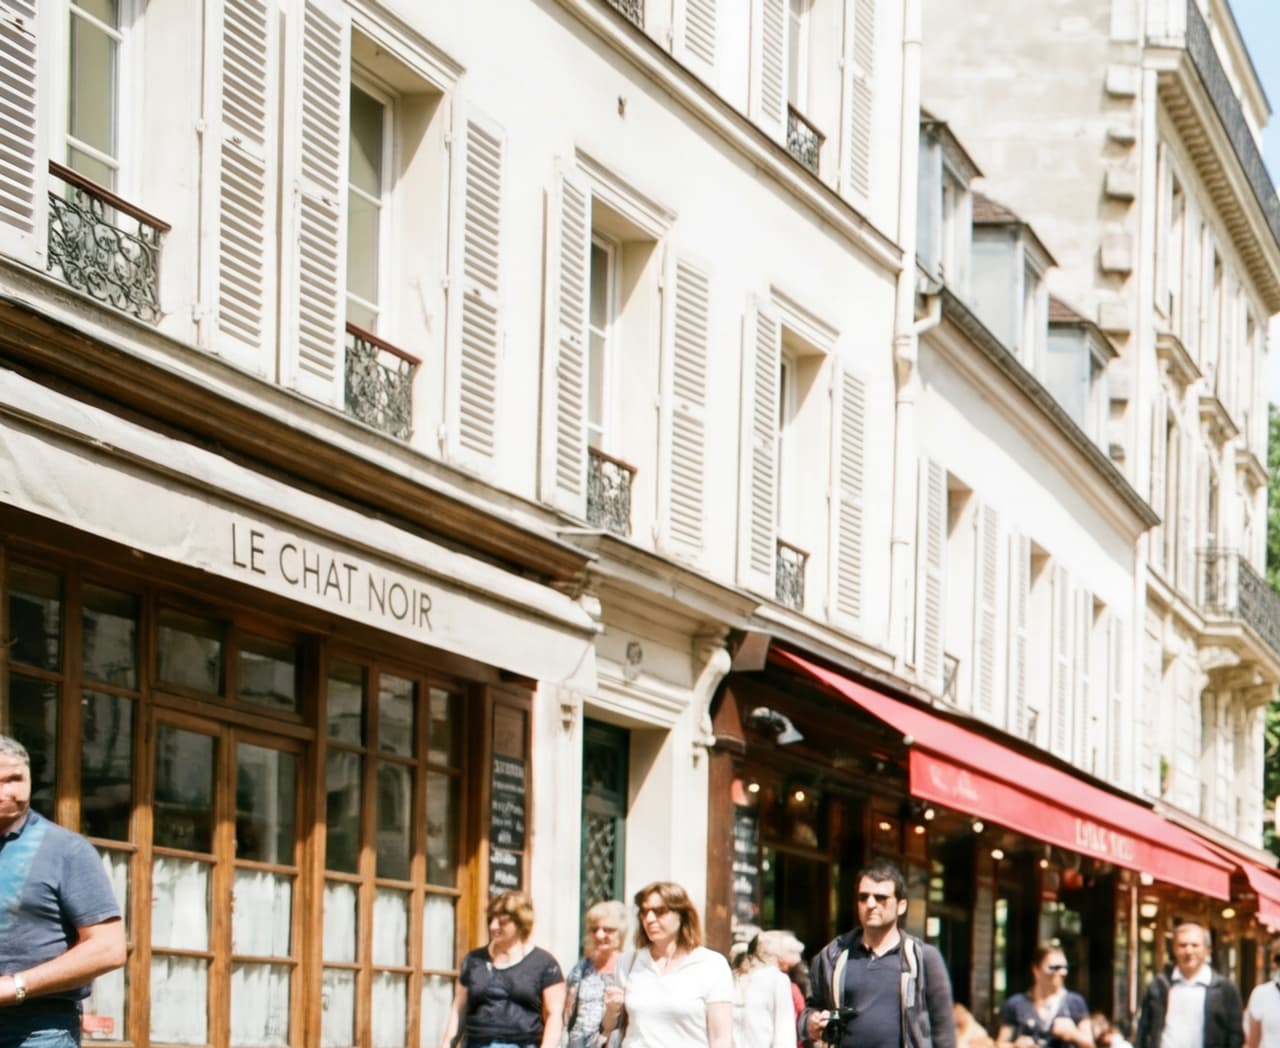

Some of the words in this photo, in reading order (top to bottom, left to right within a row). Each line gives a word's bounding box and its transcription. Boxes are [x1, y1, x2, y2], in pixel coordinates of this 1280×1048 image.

[231, 522, 267, 576] LE
[279, 543, 359, 605] CHAT
[367, 572, 433, 633] NOIR
